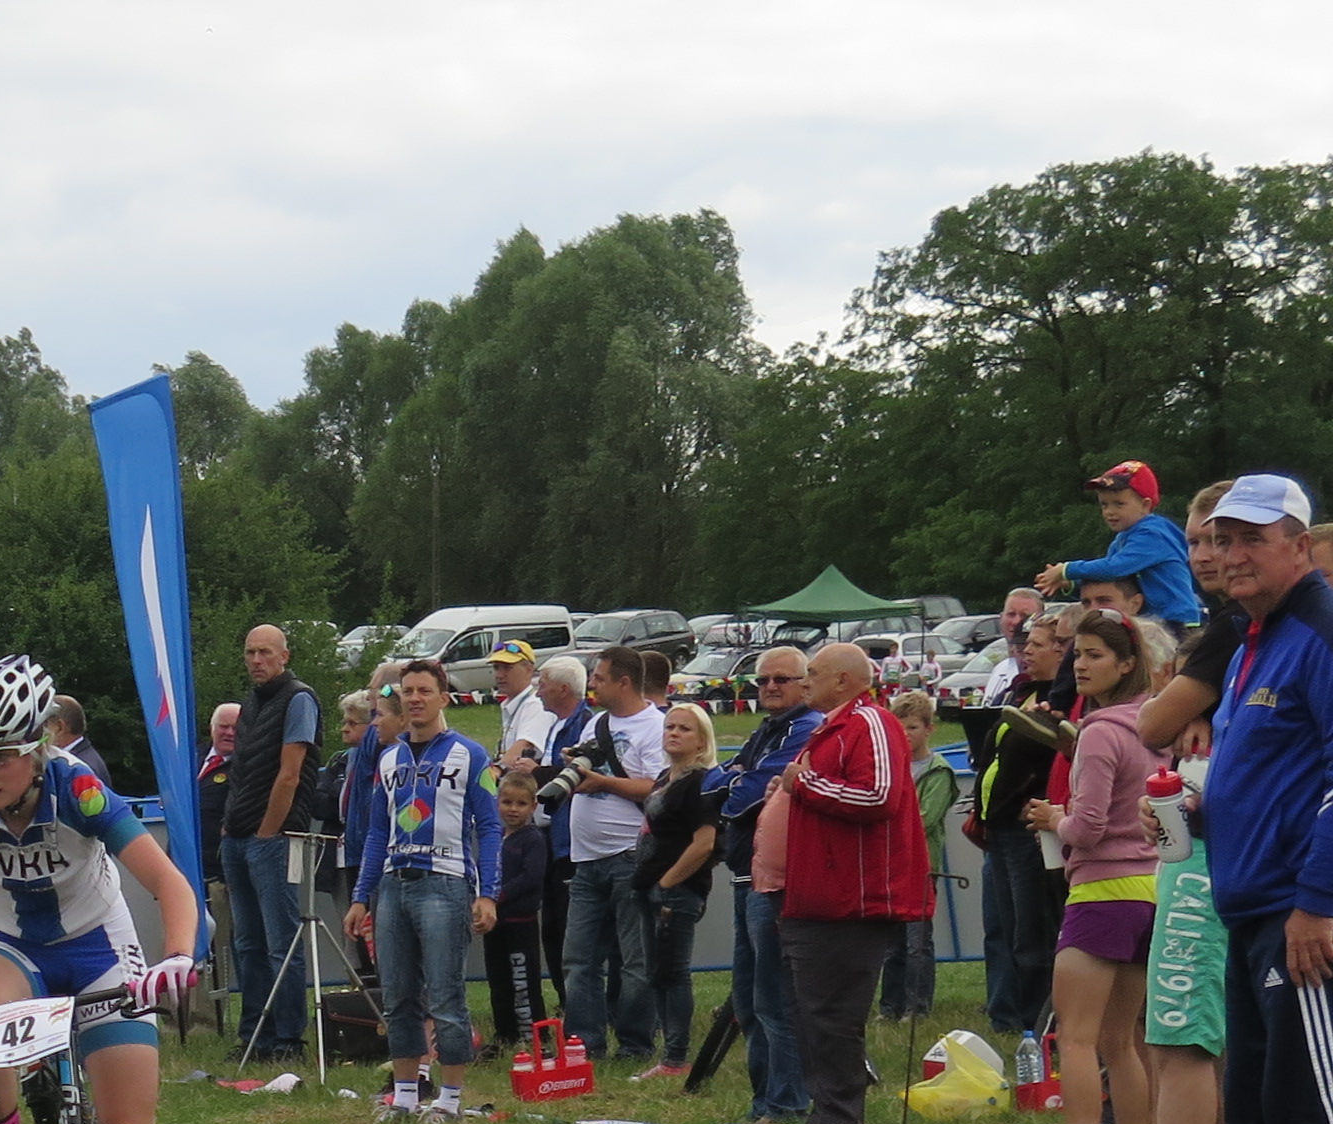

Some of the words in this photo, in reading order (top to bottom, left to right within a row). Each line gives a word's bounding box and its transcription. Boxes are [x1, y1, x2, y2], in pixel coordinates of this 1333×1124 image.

[384, 766, 461, 792] WKK
[1154, 961, 1196, 1028] 1979
[1, 1015, 36, 1048] 42
